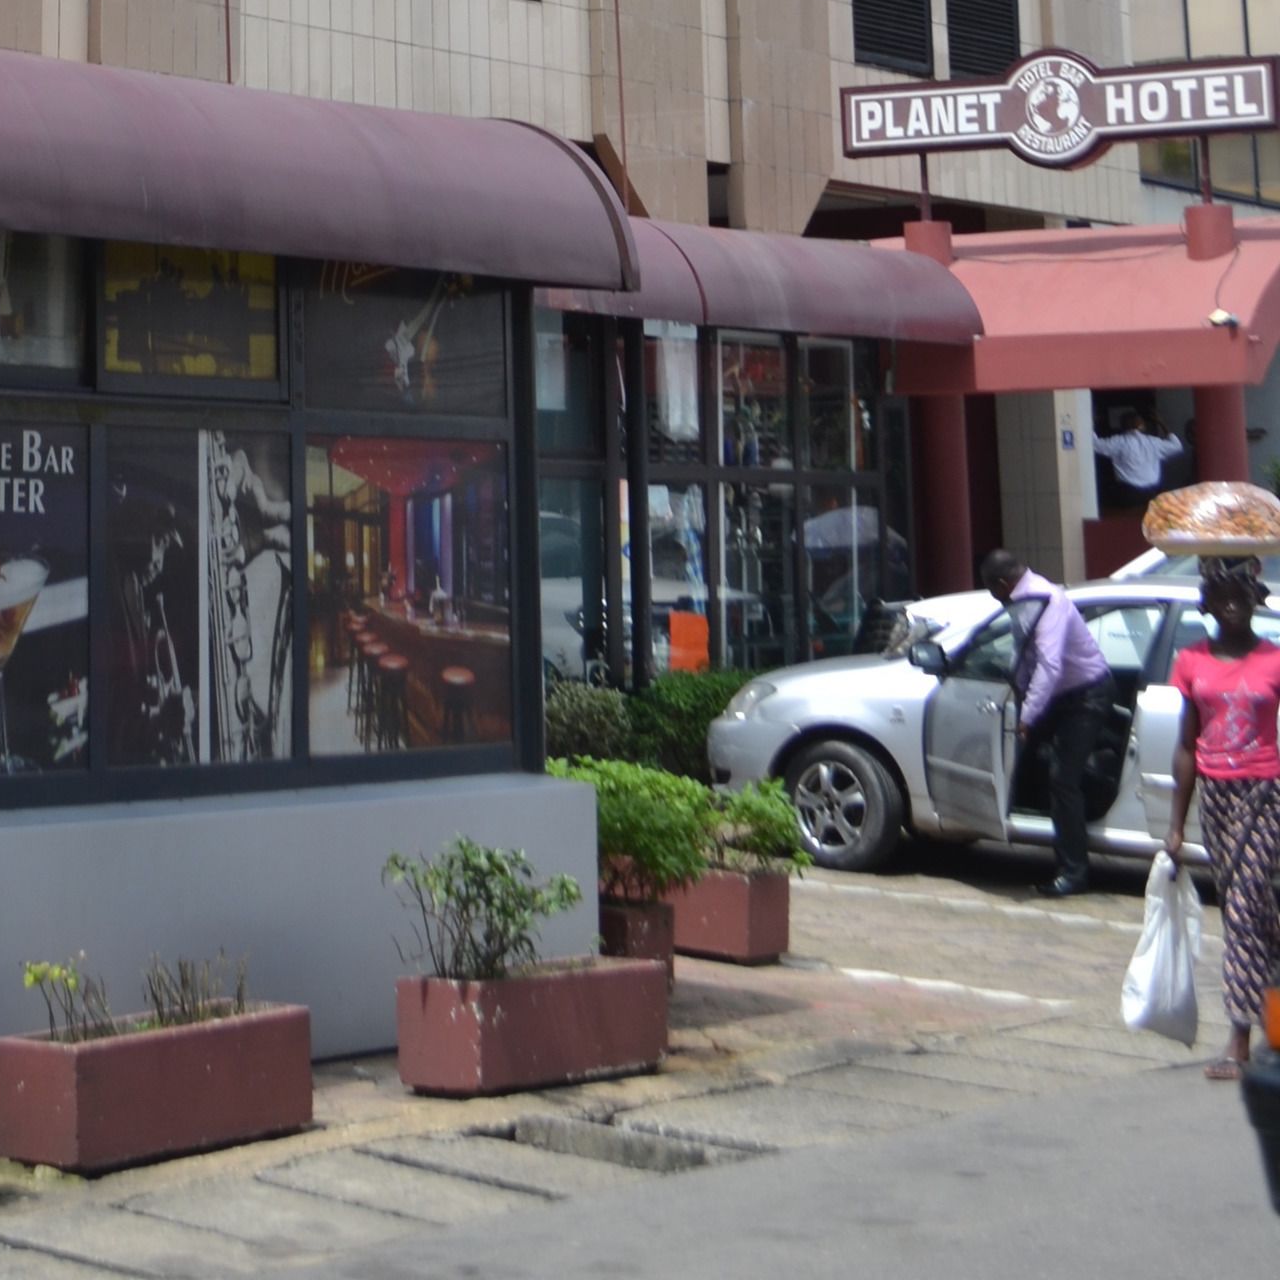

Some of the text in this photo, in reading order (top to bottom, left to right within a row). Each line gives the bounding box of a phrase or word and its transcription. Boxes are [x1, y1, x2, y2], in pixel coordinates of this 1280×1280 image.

[1017, 62, 1054, 93] HOTEL
[859, 74, 1258, 139] PLANET HOTEL
[1016, 115, 1092, 153] RESTAURANT
